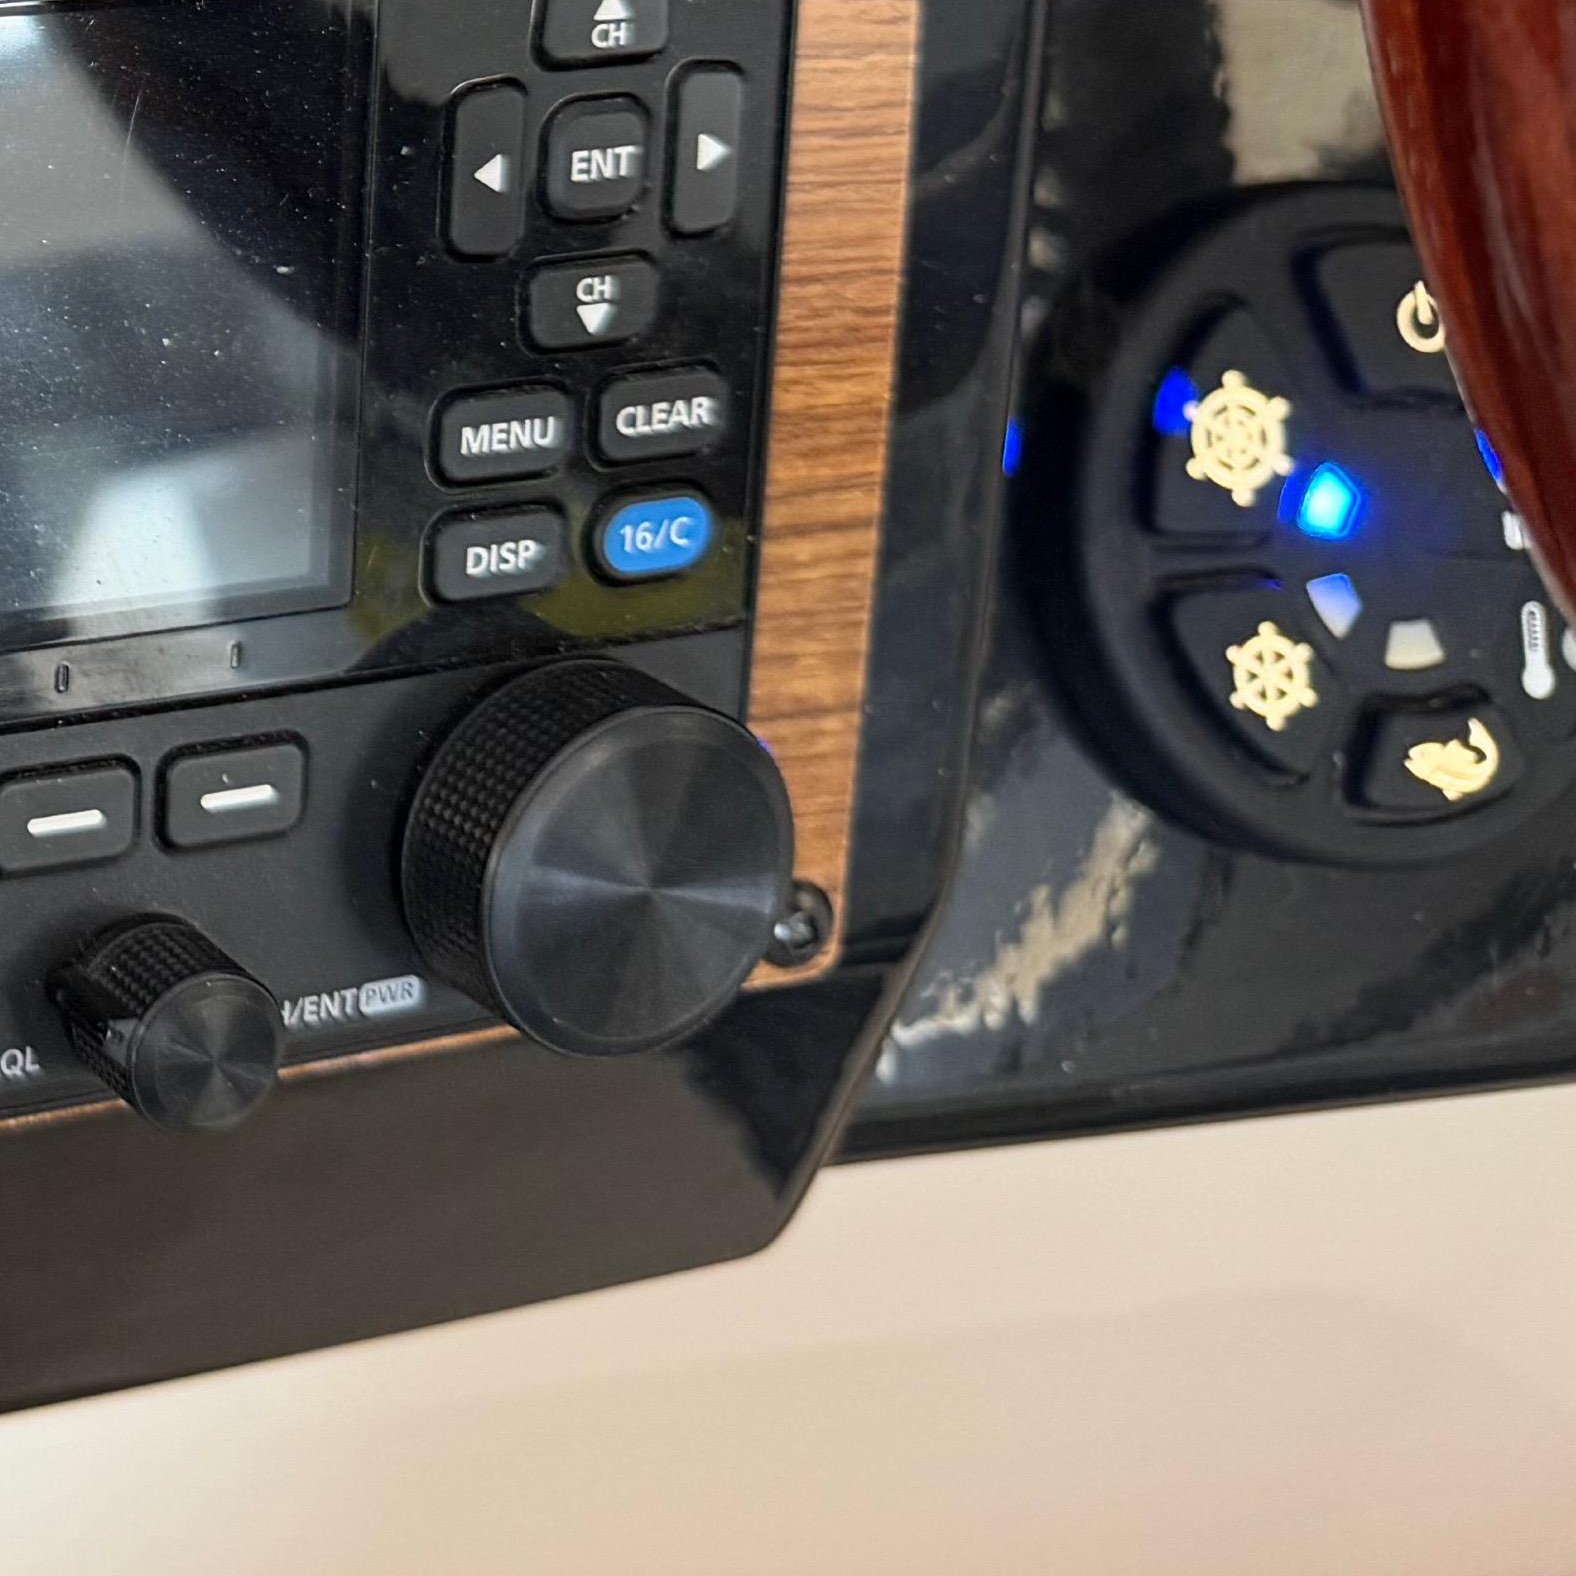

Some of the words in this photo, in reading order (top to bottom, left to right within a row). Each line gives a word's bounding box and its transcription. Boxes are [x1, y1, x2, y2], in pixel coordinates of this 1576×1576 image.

[591, 21, 627, 49] CH
[571, 146, 639, 183] ENT
[576, 276, 614, 304] CH
[615, 397, 715, 436] CLEAR
[459, 416, 555, 456] MENU
[619, 518, 691, 551] 16/C
[466, 539, 541, 576] DISP
[364, 980, 417, 1008] PWR
